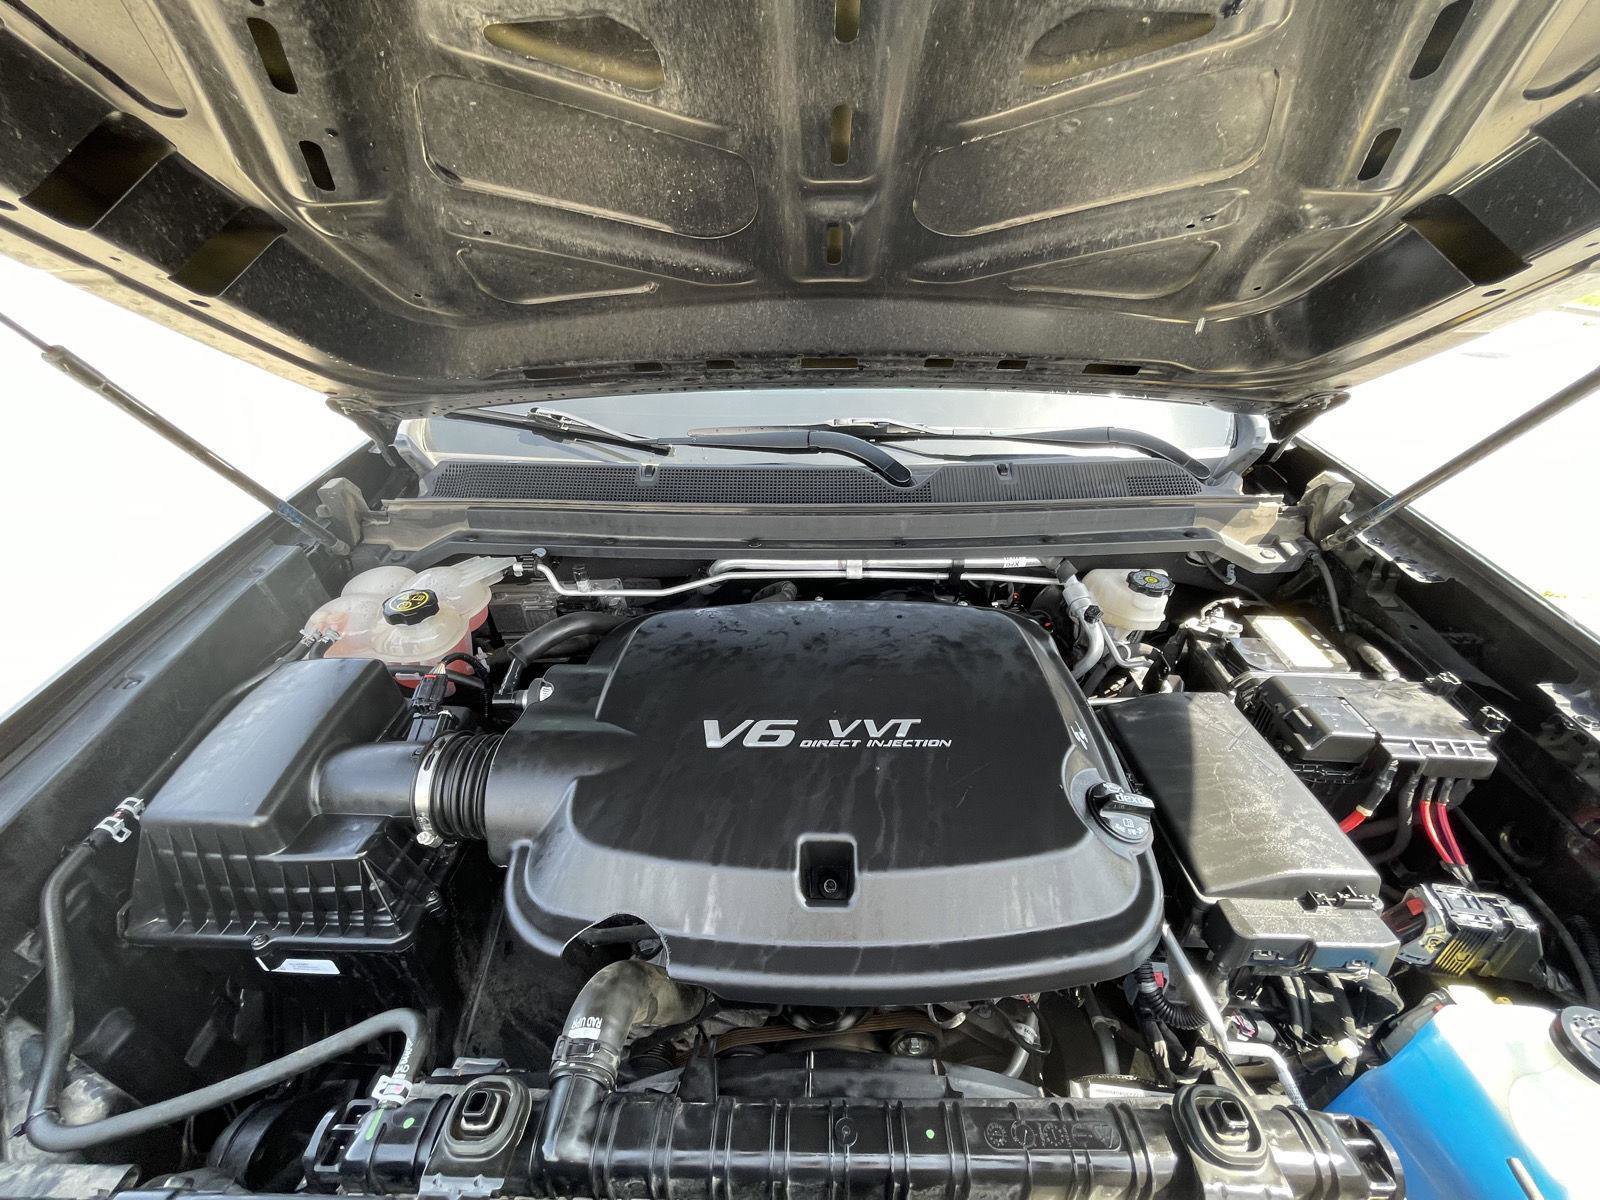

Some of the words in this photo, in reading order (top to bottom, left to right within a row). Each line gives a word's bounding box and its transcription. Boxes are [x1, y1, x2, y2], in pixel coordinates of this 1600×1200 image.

[703, 719, 799, 748] V6
[828, 718, 922, 738] VVT
[799, 738, 862, 748] DIRECT
[866, 738, 952, 748] INJECTION
[587, 1016, 603, 1029] RAD
